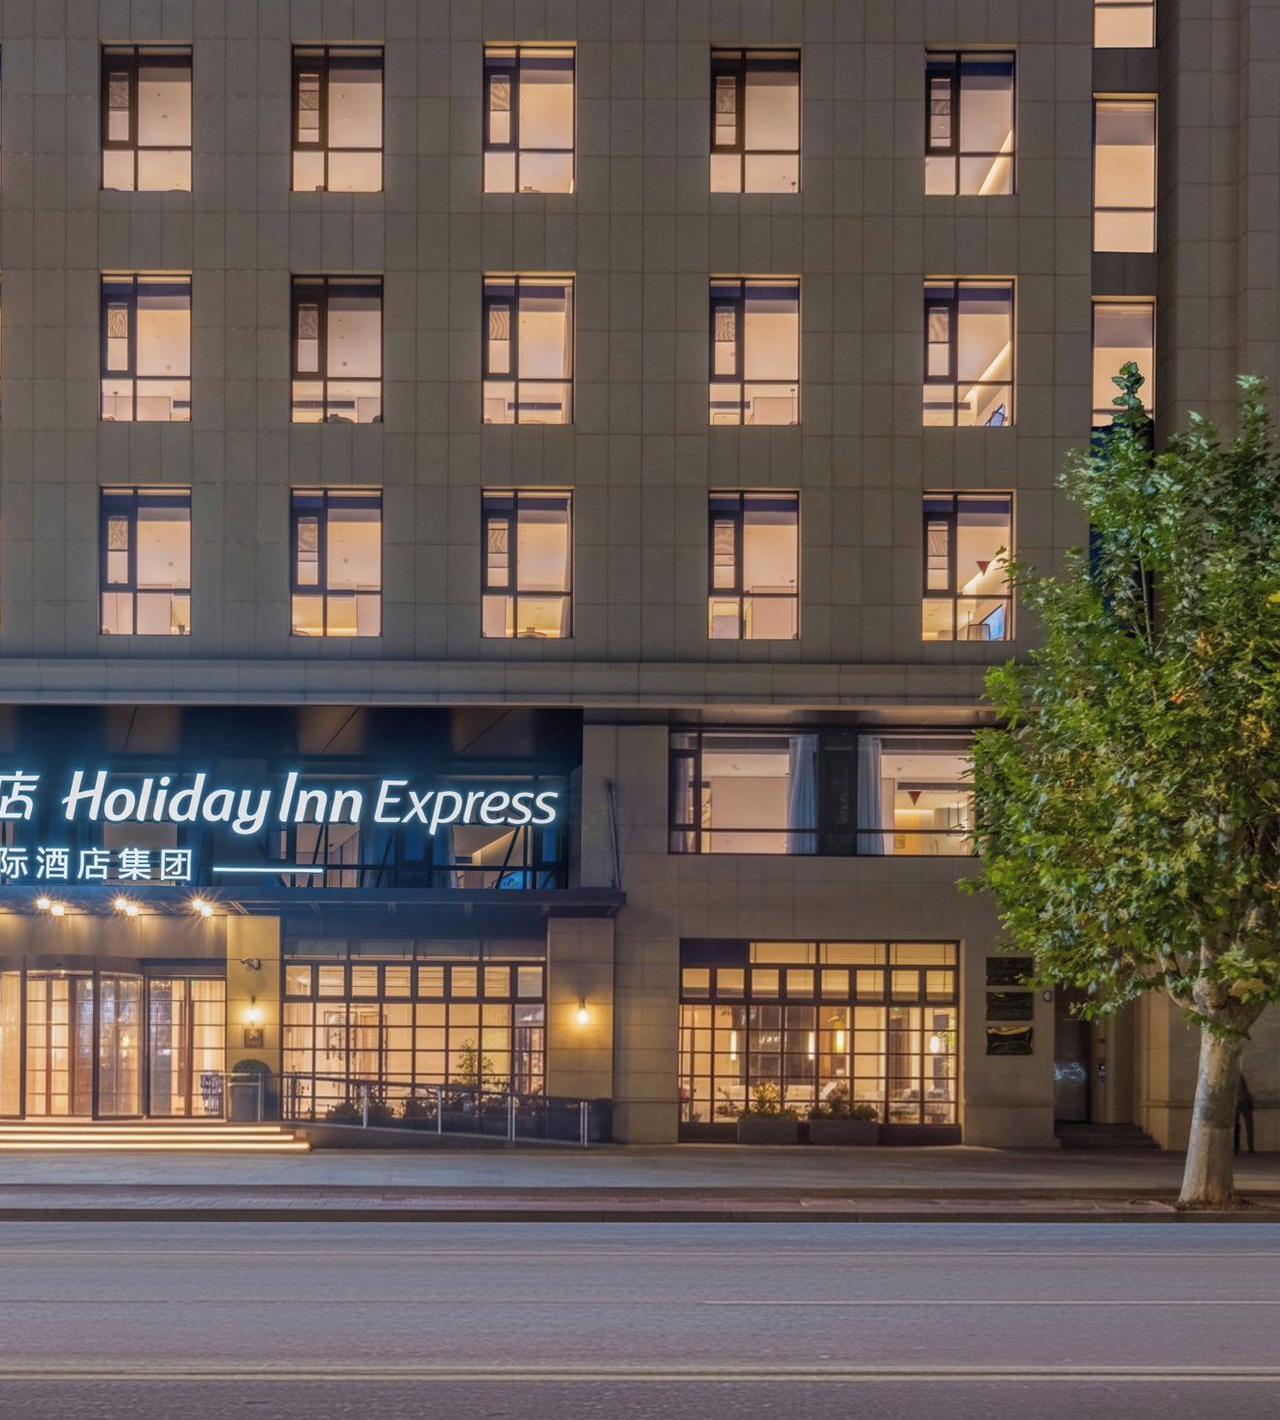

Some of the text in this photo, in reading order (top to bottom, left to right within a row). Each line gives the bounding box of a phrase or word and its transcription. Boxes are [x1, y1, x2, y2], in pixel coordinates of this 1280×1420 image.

[60, 769, 559, 837] Holiday Inn Express
